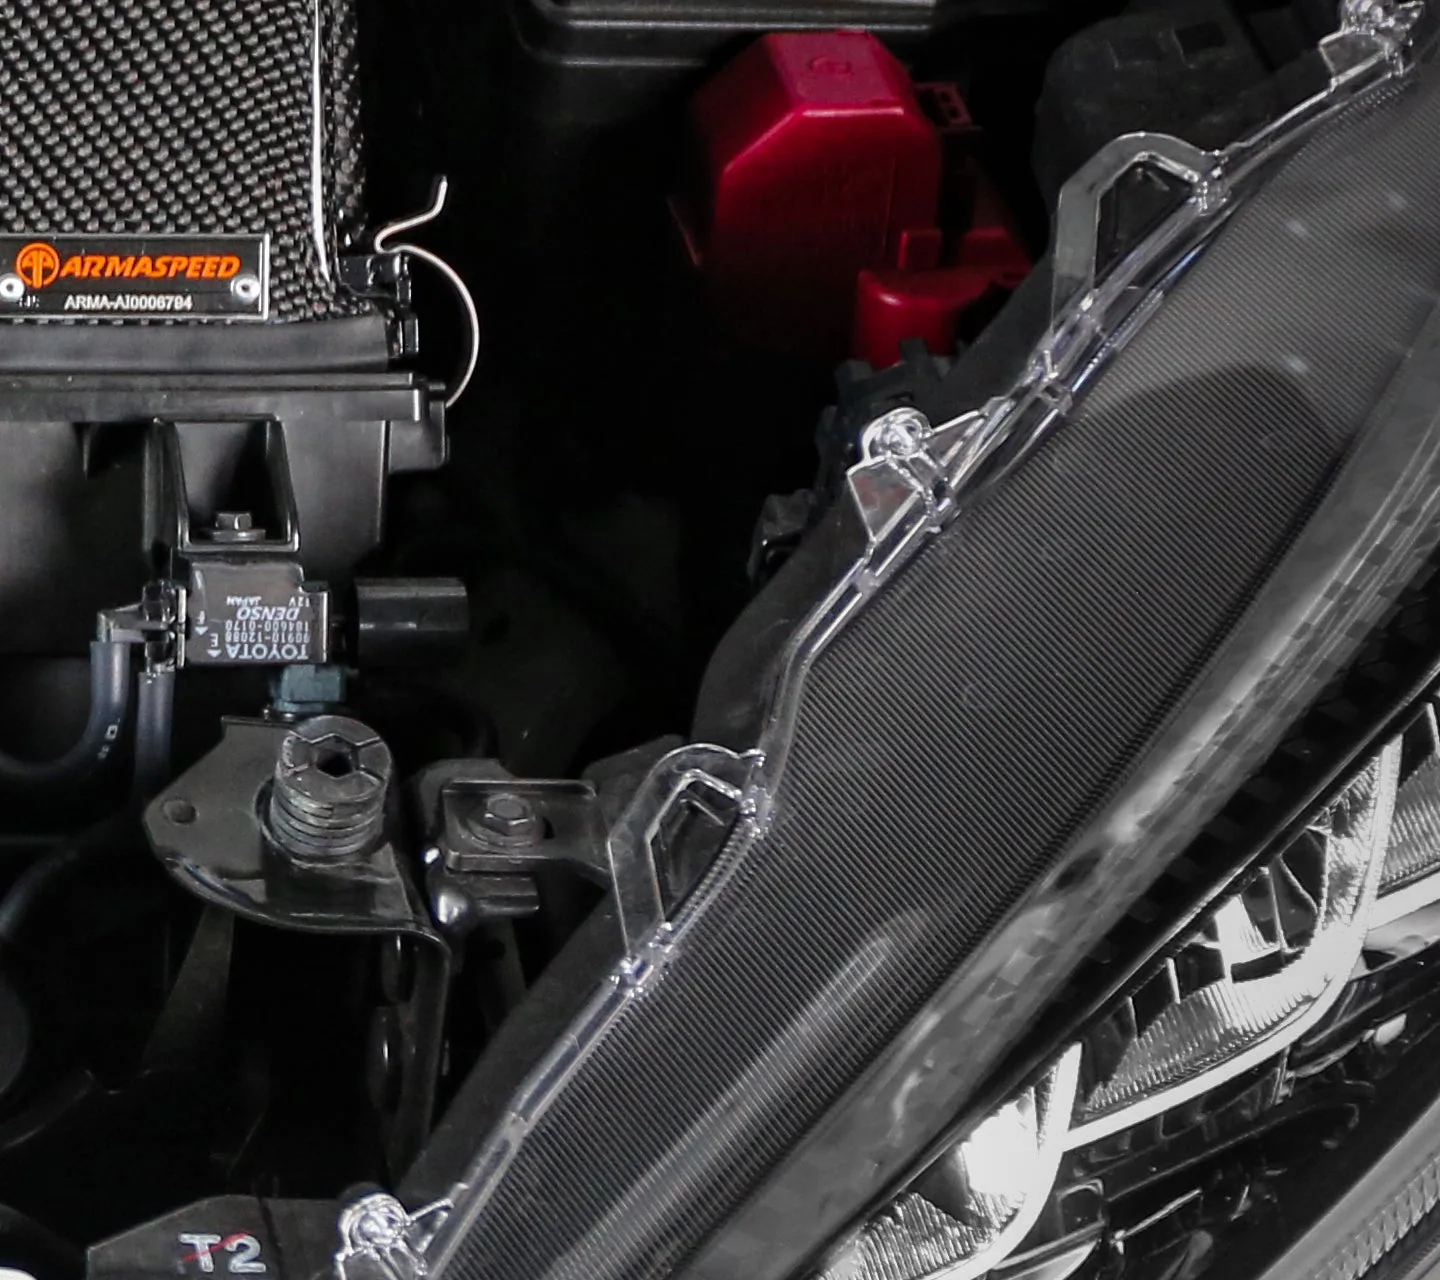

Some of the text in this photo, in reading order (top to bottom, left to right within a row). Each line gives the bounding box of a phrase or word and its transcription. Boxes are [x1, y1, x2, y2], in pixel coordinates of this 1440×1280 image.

[59, 255, 241, 280] ARMASPEED
[226, 596, 262, 607] JAPAN
[236, 606, 300, 620] DENSO
[225, 643, 309, 660] TOYOTA
[180, 1232, 266, 1273] T2
